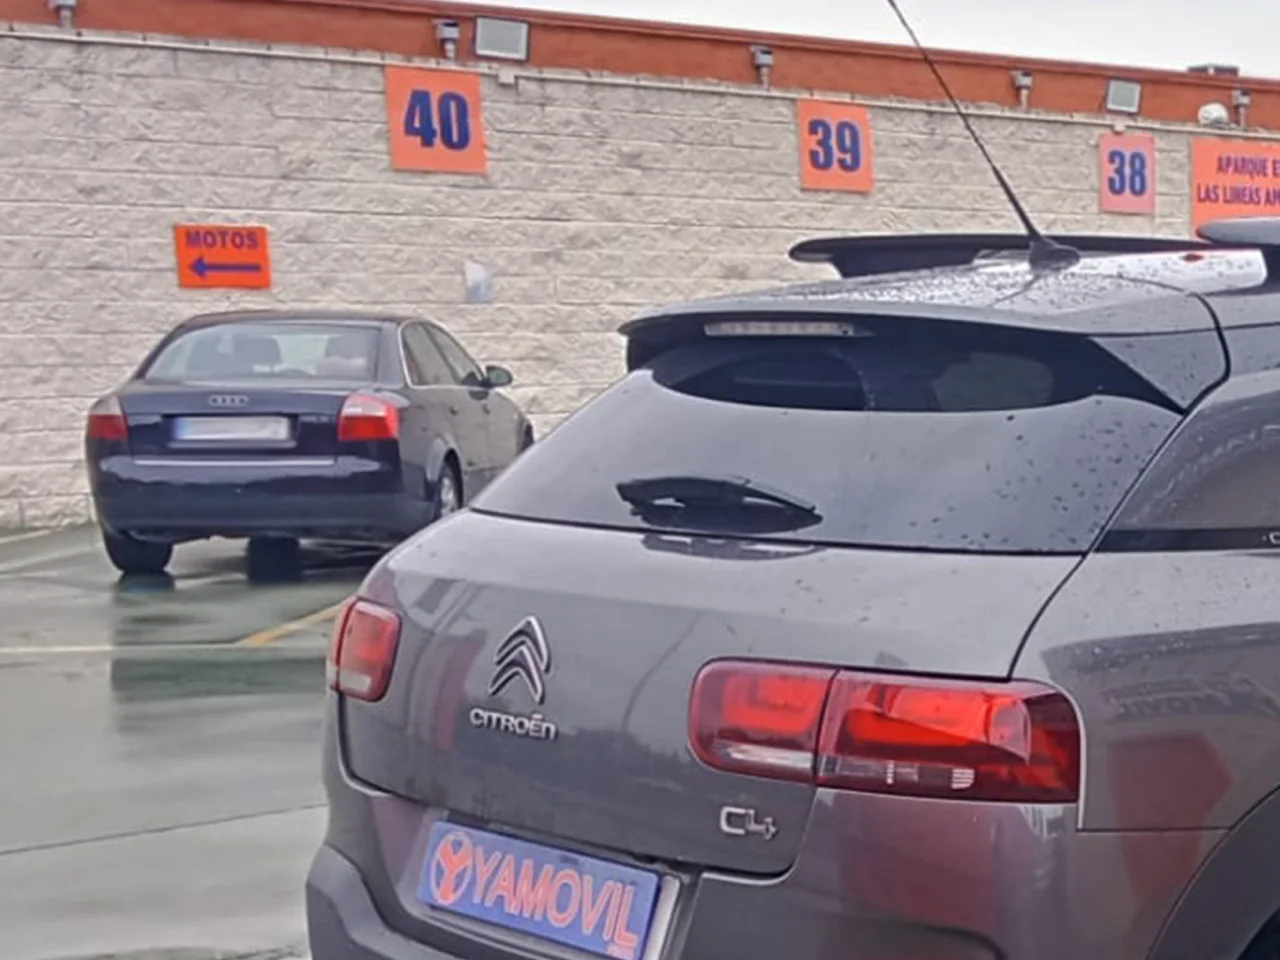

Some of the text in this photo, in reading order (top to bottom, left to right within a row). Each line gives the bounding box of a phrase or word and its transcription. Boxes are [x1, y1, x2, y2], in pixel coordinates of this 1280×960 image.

[403, 89, 470, 150] 40
[808, 119, 861, 172] 39
[1108, 150, 1146, 197] 38
[1217, 155, 1268, 179] APARQUE
[1197, 183, 1219, 203] LAS
[185, 229, 258, 249] MOTOS
[719, 806, 778, 840] C4
[472, 845, 638, 948] YAMOVIL
